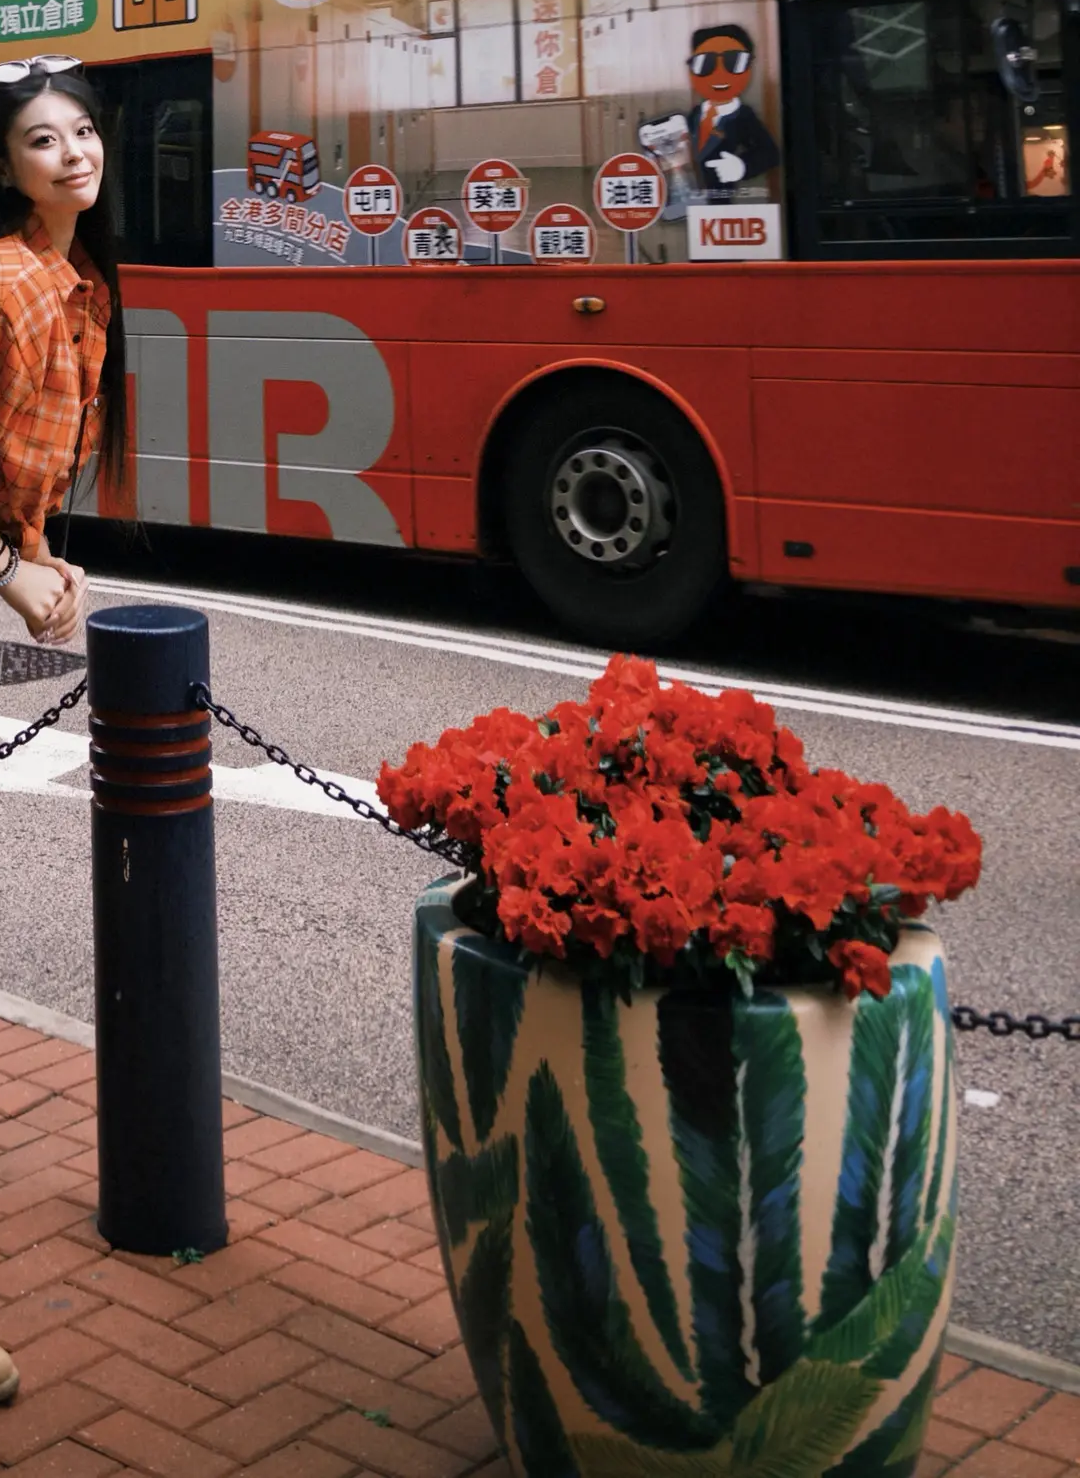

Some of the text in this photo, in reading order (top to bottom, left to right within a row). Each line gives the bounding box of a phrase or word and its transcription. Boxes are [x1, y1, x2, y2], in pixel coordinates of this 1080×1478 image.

[354, 188, 393, 212] 屯門
[606, 179, 653, 205] 油塘
[220, 198, 351, 255] 全港多間分店
[413, 231, 454, 256] 青衣
[540, 229, 586, 255] 觀塘
